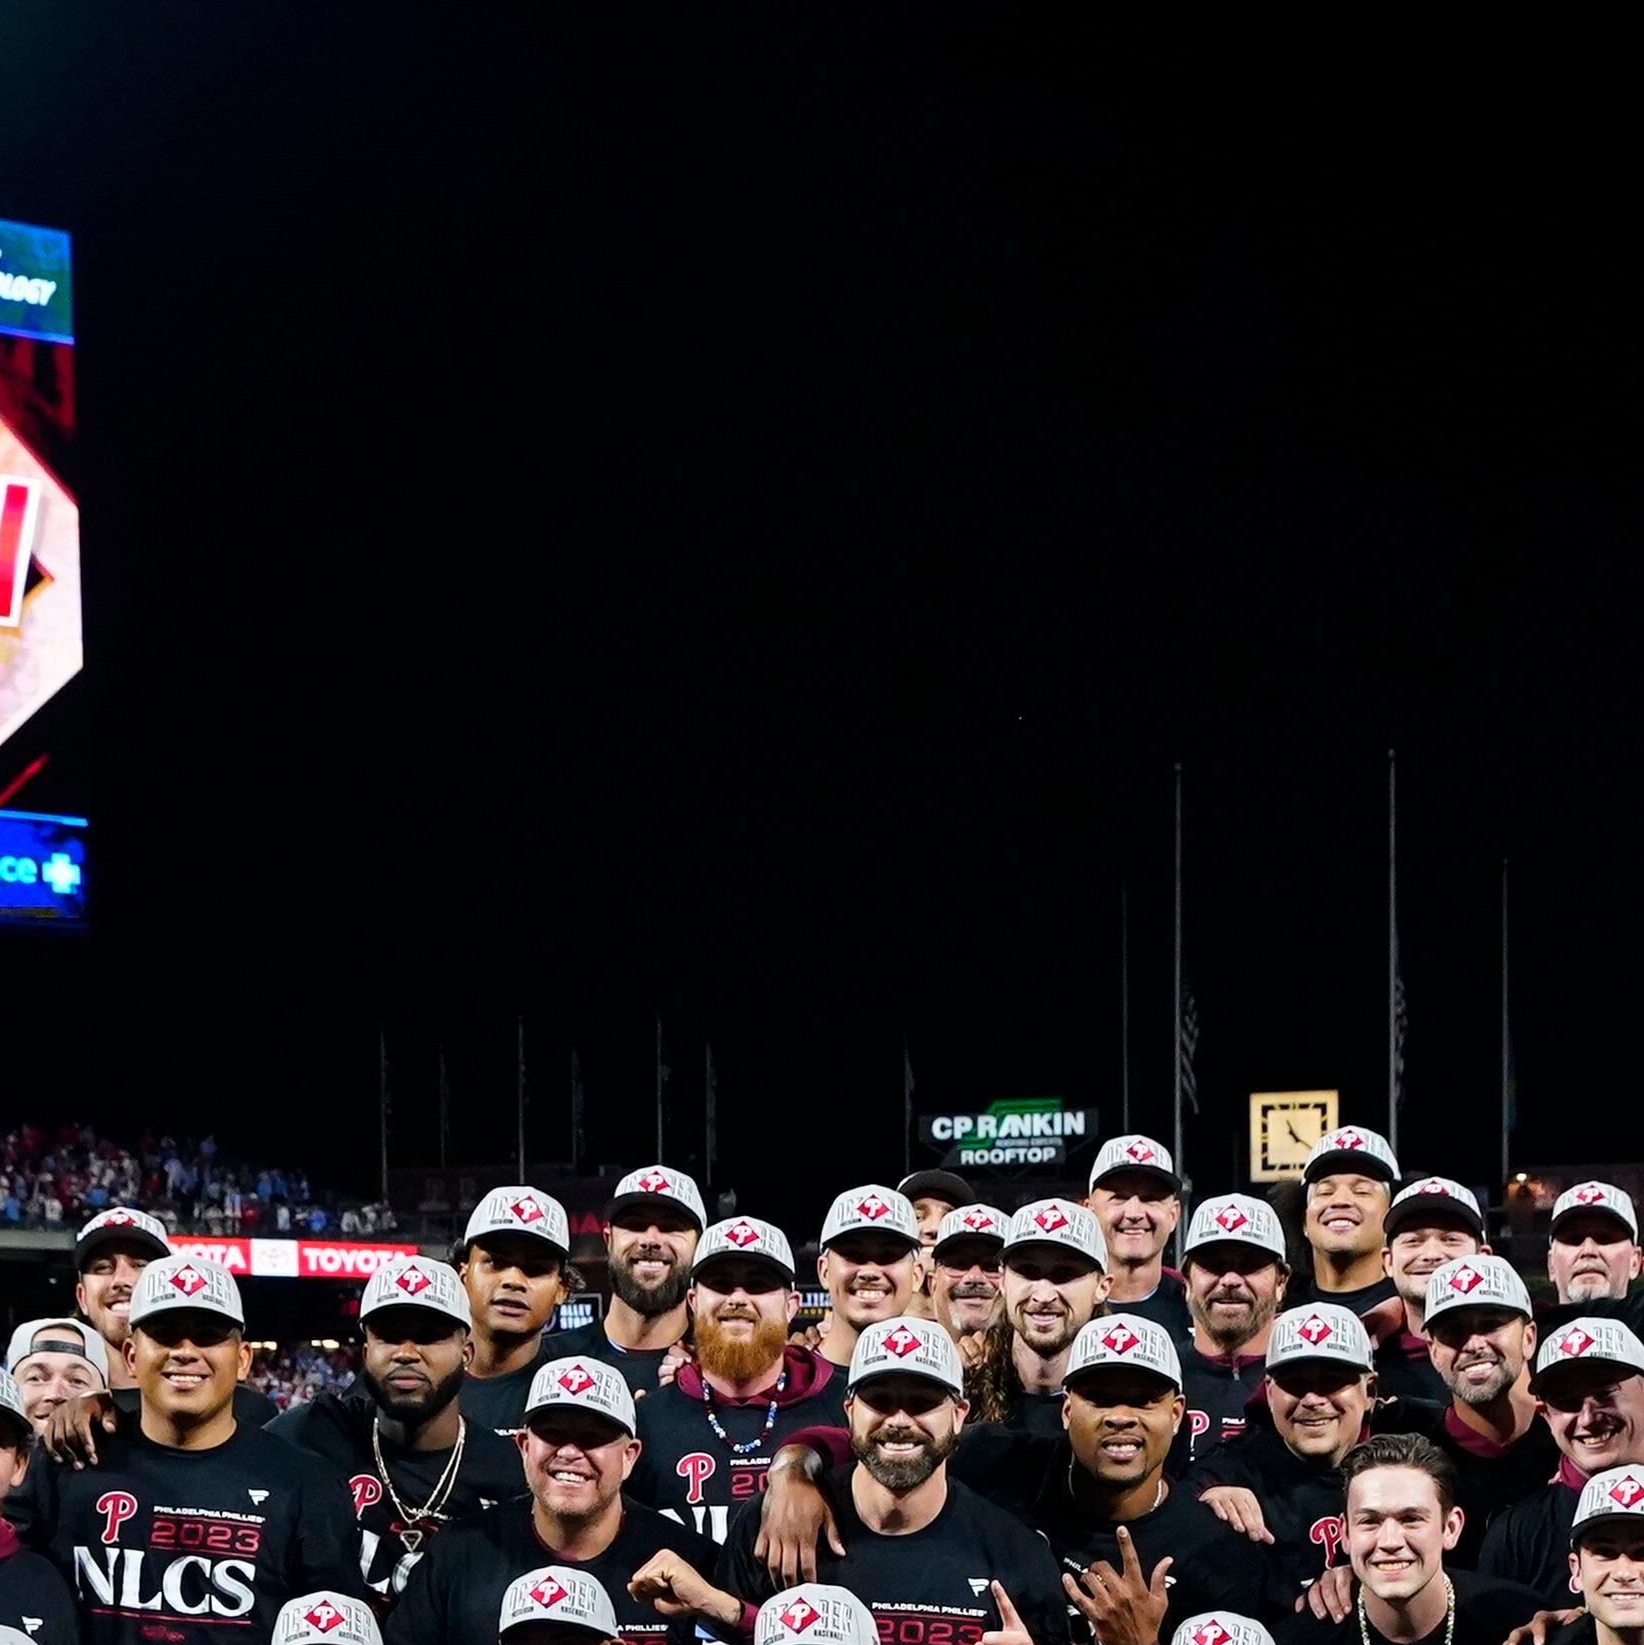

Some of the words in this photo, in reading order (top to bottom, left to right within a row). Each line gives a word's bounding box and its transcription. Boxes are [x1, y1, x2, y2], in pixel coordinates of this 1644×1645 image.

[931, 1115, 973, 1140] CP
[976, 1111, 1086, 1139] RANKIN
[960, 1147, 1057, 1165] ROOFTOP
[676, 1452, 717, 1504] P
[96, 1490, 139, 1544] P
[153, 1504, 222, 1519] PHILADELPHIA
[222, 1511, 266, 1525] PHILLIES
[150, 1522, 262, 1553] 2023
[73, 1545, 256, 1618] NLCS
[871, 1601, 942, 1615] PHILADELPHIA
[942, 1605, 988, 1617] PHILLIES
